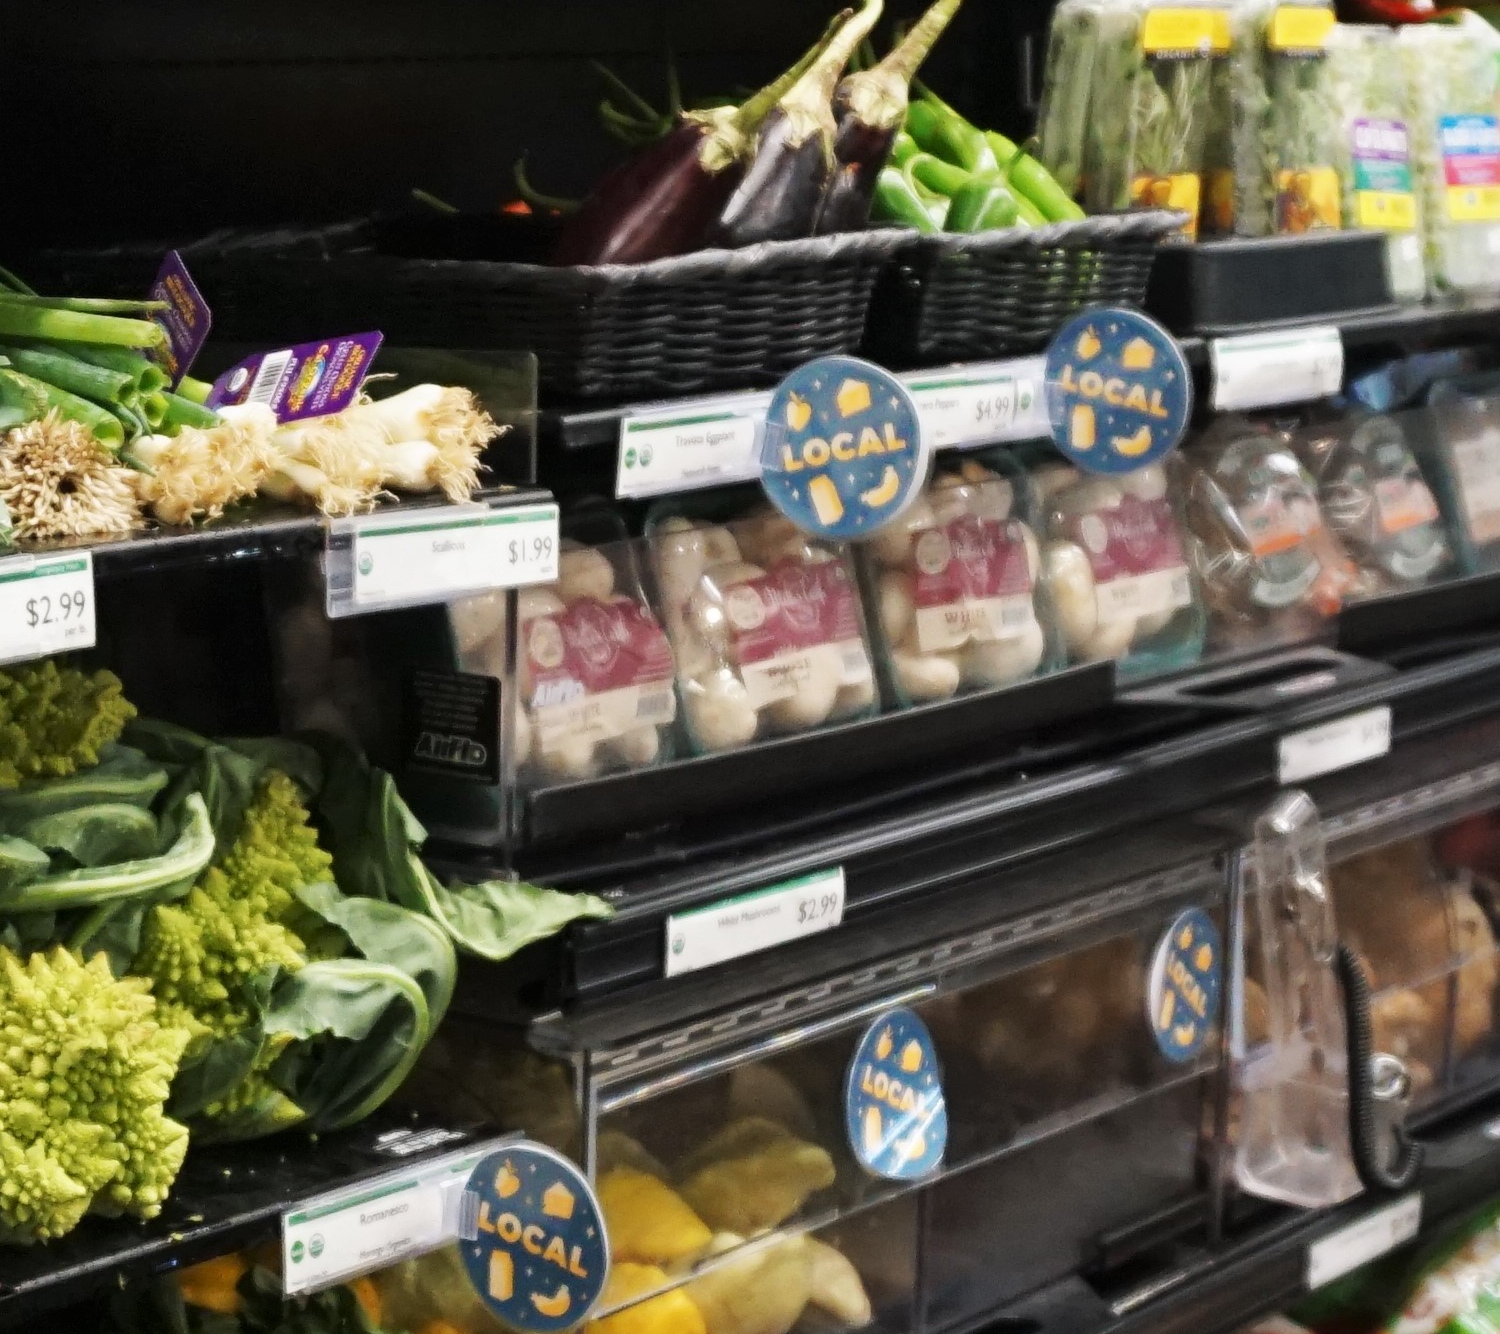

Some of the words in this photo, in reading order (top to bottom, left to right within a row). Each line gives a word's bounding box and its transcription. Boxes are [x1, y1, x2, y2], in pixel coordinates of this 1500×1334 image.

[975, 396, 1009, 423] $4.99
[1061, 364, 1168, 419] LOCAL
[781, 423, 906, 473] LOCAL
[432, 538, 466, 555] Scallions
[508, 535, 555, 566] $1.99
[26, 589, 87, 629] $2.99
[797, 892, 839, 924] $2.99
[1168, 951, 1208, 1019] LOCAL
[862, 1064, 932, 1123] LOCAL
[359, 1201, 409, 1227] Romanesco
[478, 1200, 588, 1280] LOCAL
